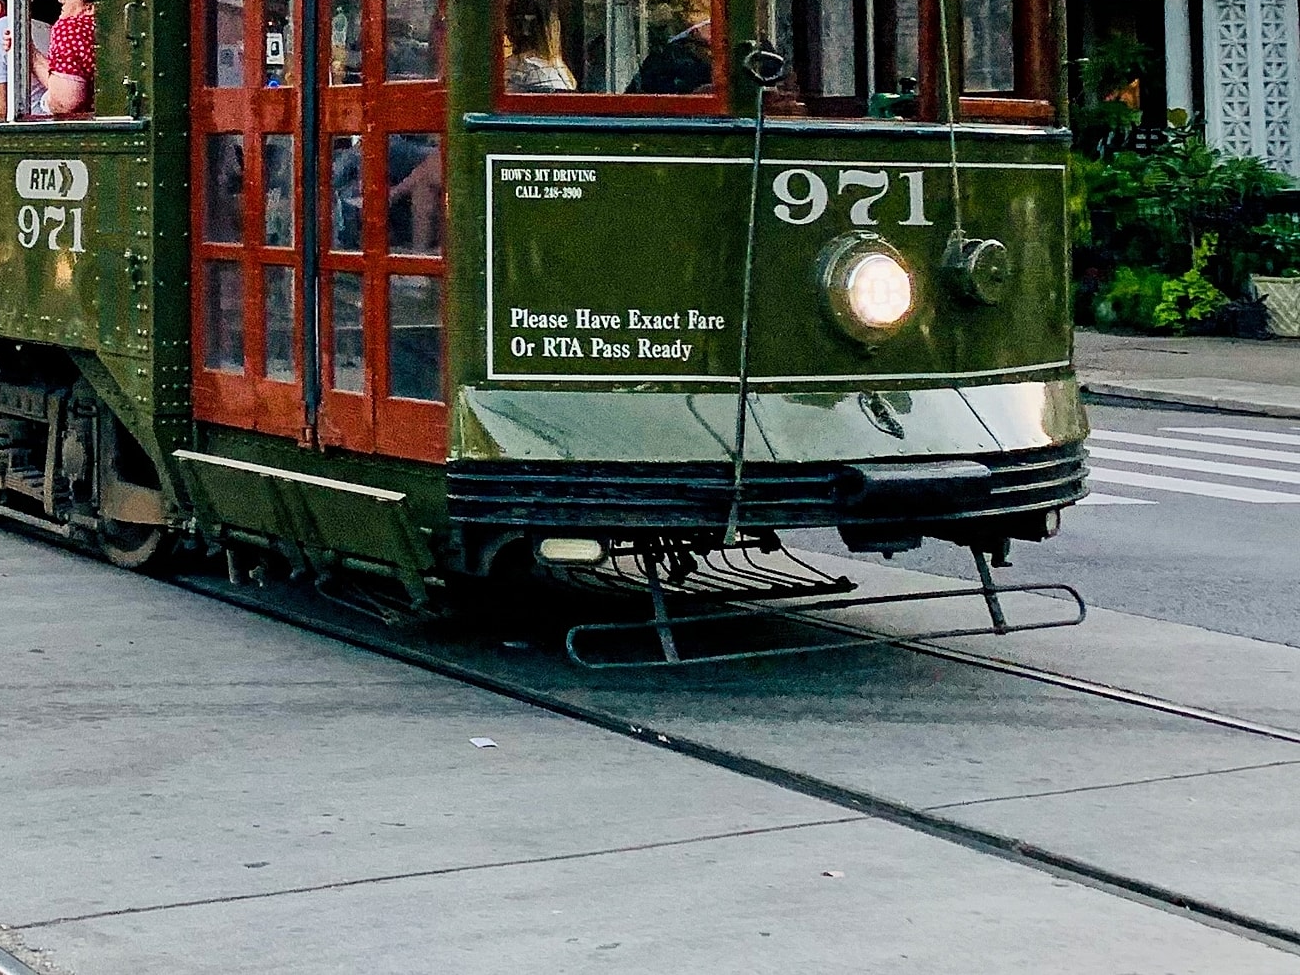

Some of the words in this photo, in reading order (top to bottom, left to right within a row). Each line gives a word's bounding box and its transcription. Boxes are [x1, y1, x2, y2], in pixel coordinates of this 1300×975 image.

[30, 168, 56, 190] RTA
[500, 168, 532, 181] HOW'S
[534, 168, 551, 182] MY
[553, 169, 597, 182] DRIVING
[515, 185, 542, 198] CALL
[772, 168, 934, 226] 971
[17, 205, 87, 253] 971
[510, 307, 568, 328] Please
[575, 308, 621, 329] Have
[627, 309, 681, 330] Exact
[687, 309, 726, 330] Fare
[510, 336, 536, 357] Or
[542, 337, 585, 358] RTA
[590, 337, 631, 358] Pass
[637, 337, 693, 362] Ready
